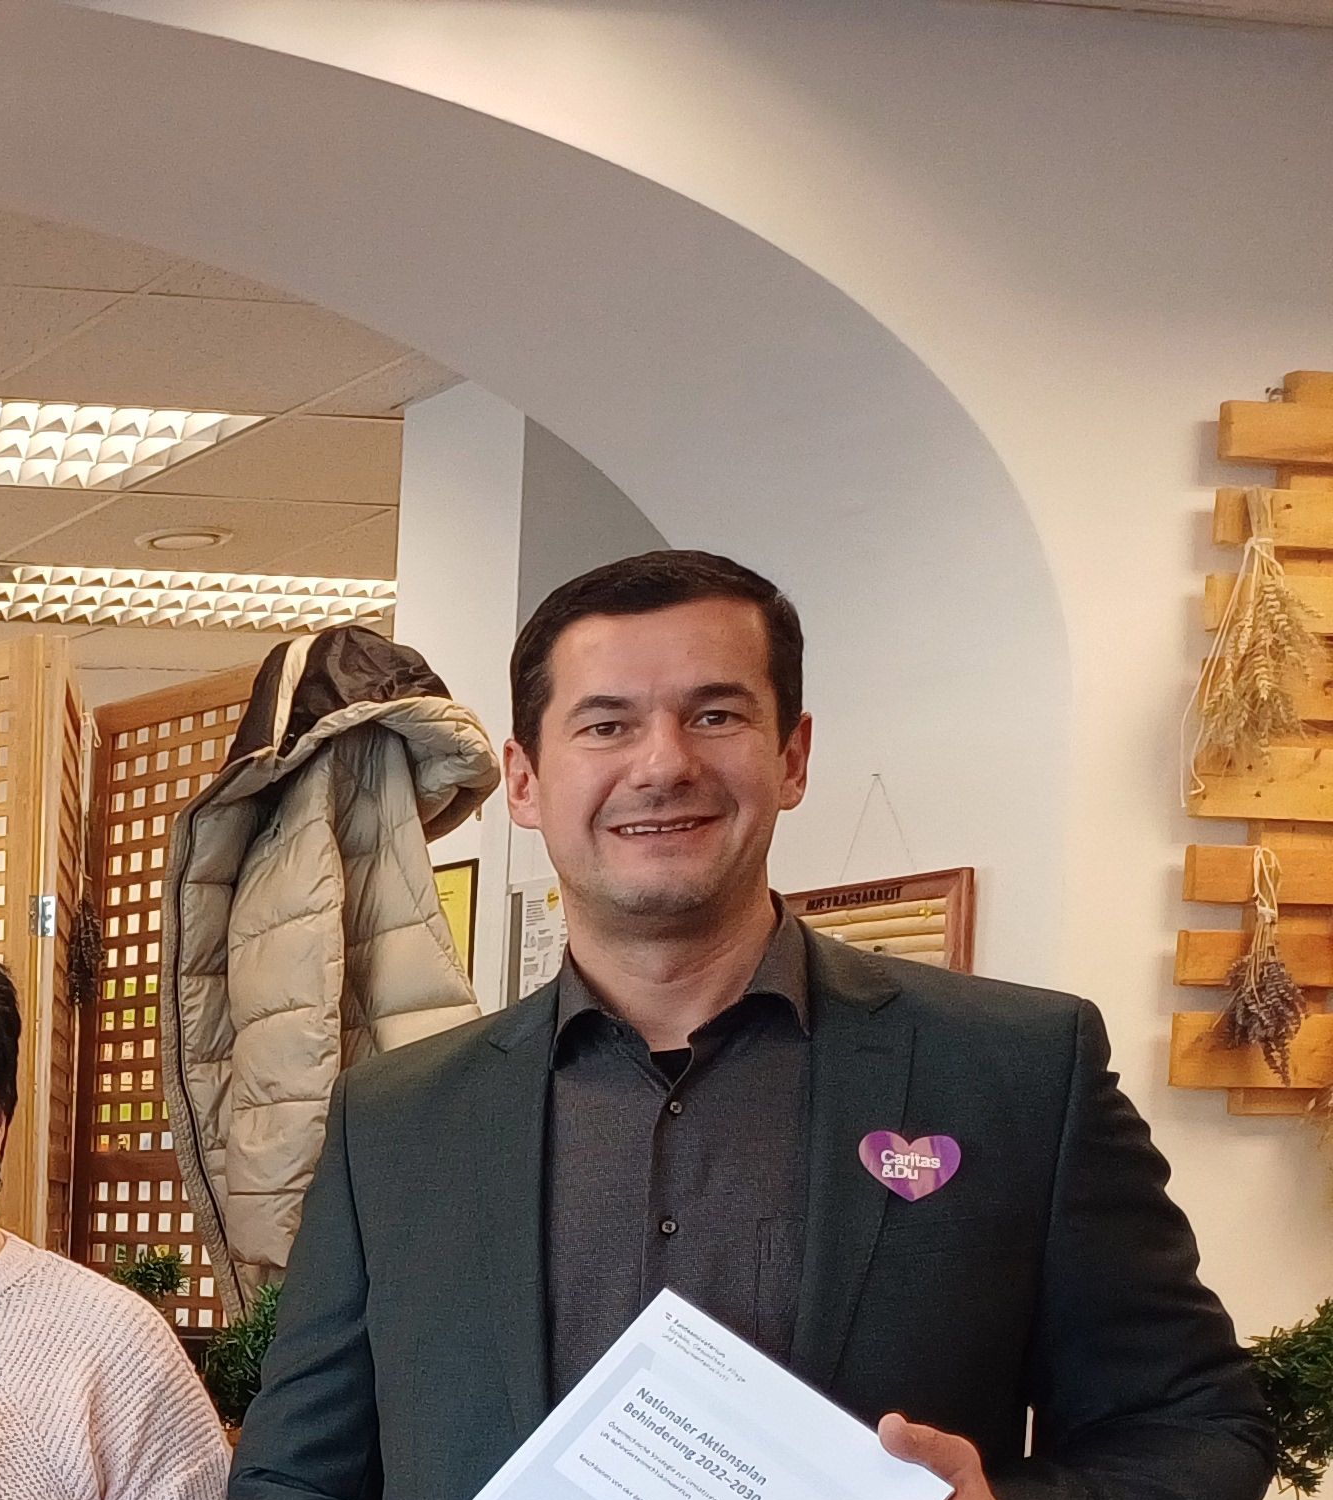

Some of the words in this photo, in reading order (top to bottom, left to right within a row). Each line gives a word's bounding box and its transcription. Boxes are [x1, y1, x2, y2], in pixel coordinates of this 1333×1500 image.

[880, 1149, 941, 1169] Caritas
[881, 1164, 919, 1180] &Du
[623, 1401, 696, 1461] Behinderung
[636, 1387, 699, 1436] Nationaler
[695, 1432, 768, 1487] Aktionsplan
